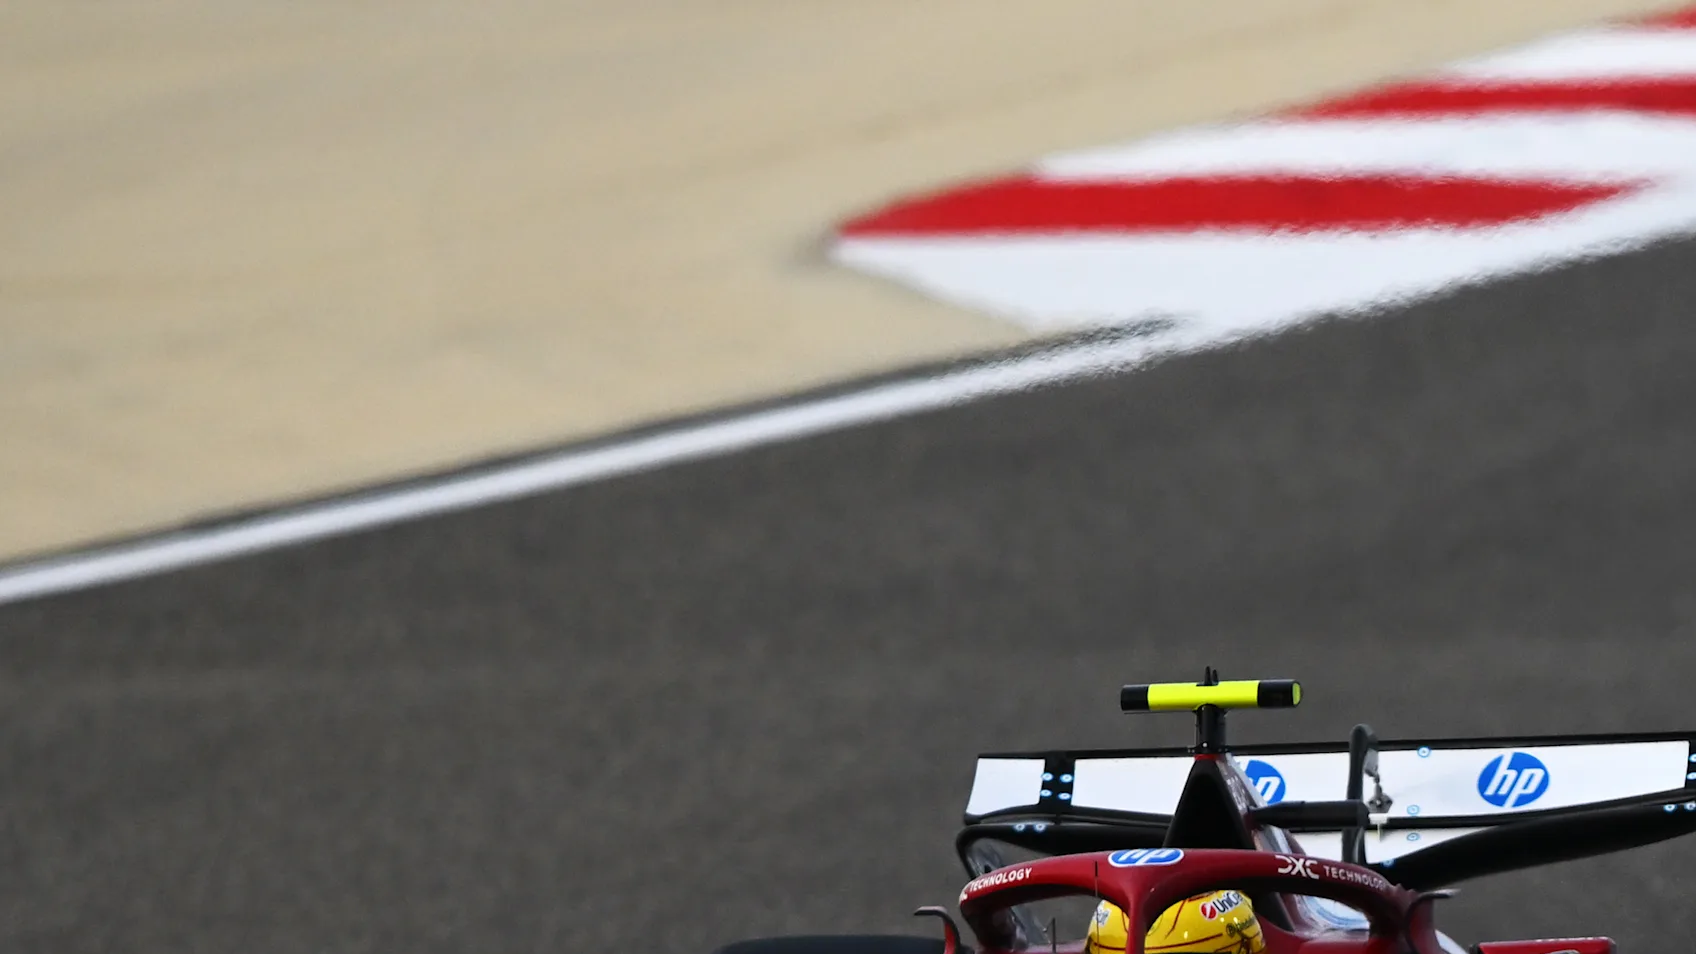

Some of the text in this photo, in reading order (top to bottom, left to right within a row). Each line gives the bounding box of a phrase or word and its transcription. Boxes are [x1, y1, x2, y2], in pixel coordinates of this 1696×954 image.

[1478, 752, 1550, 808] hp
[1275, 855, 1319, 879] DXC
[970, 868, 1032, 892] TECHNOLOGY
